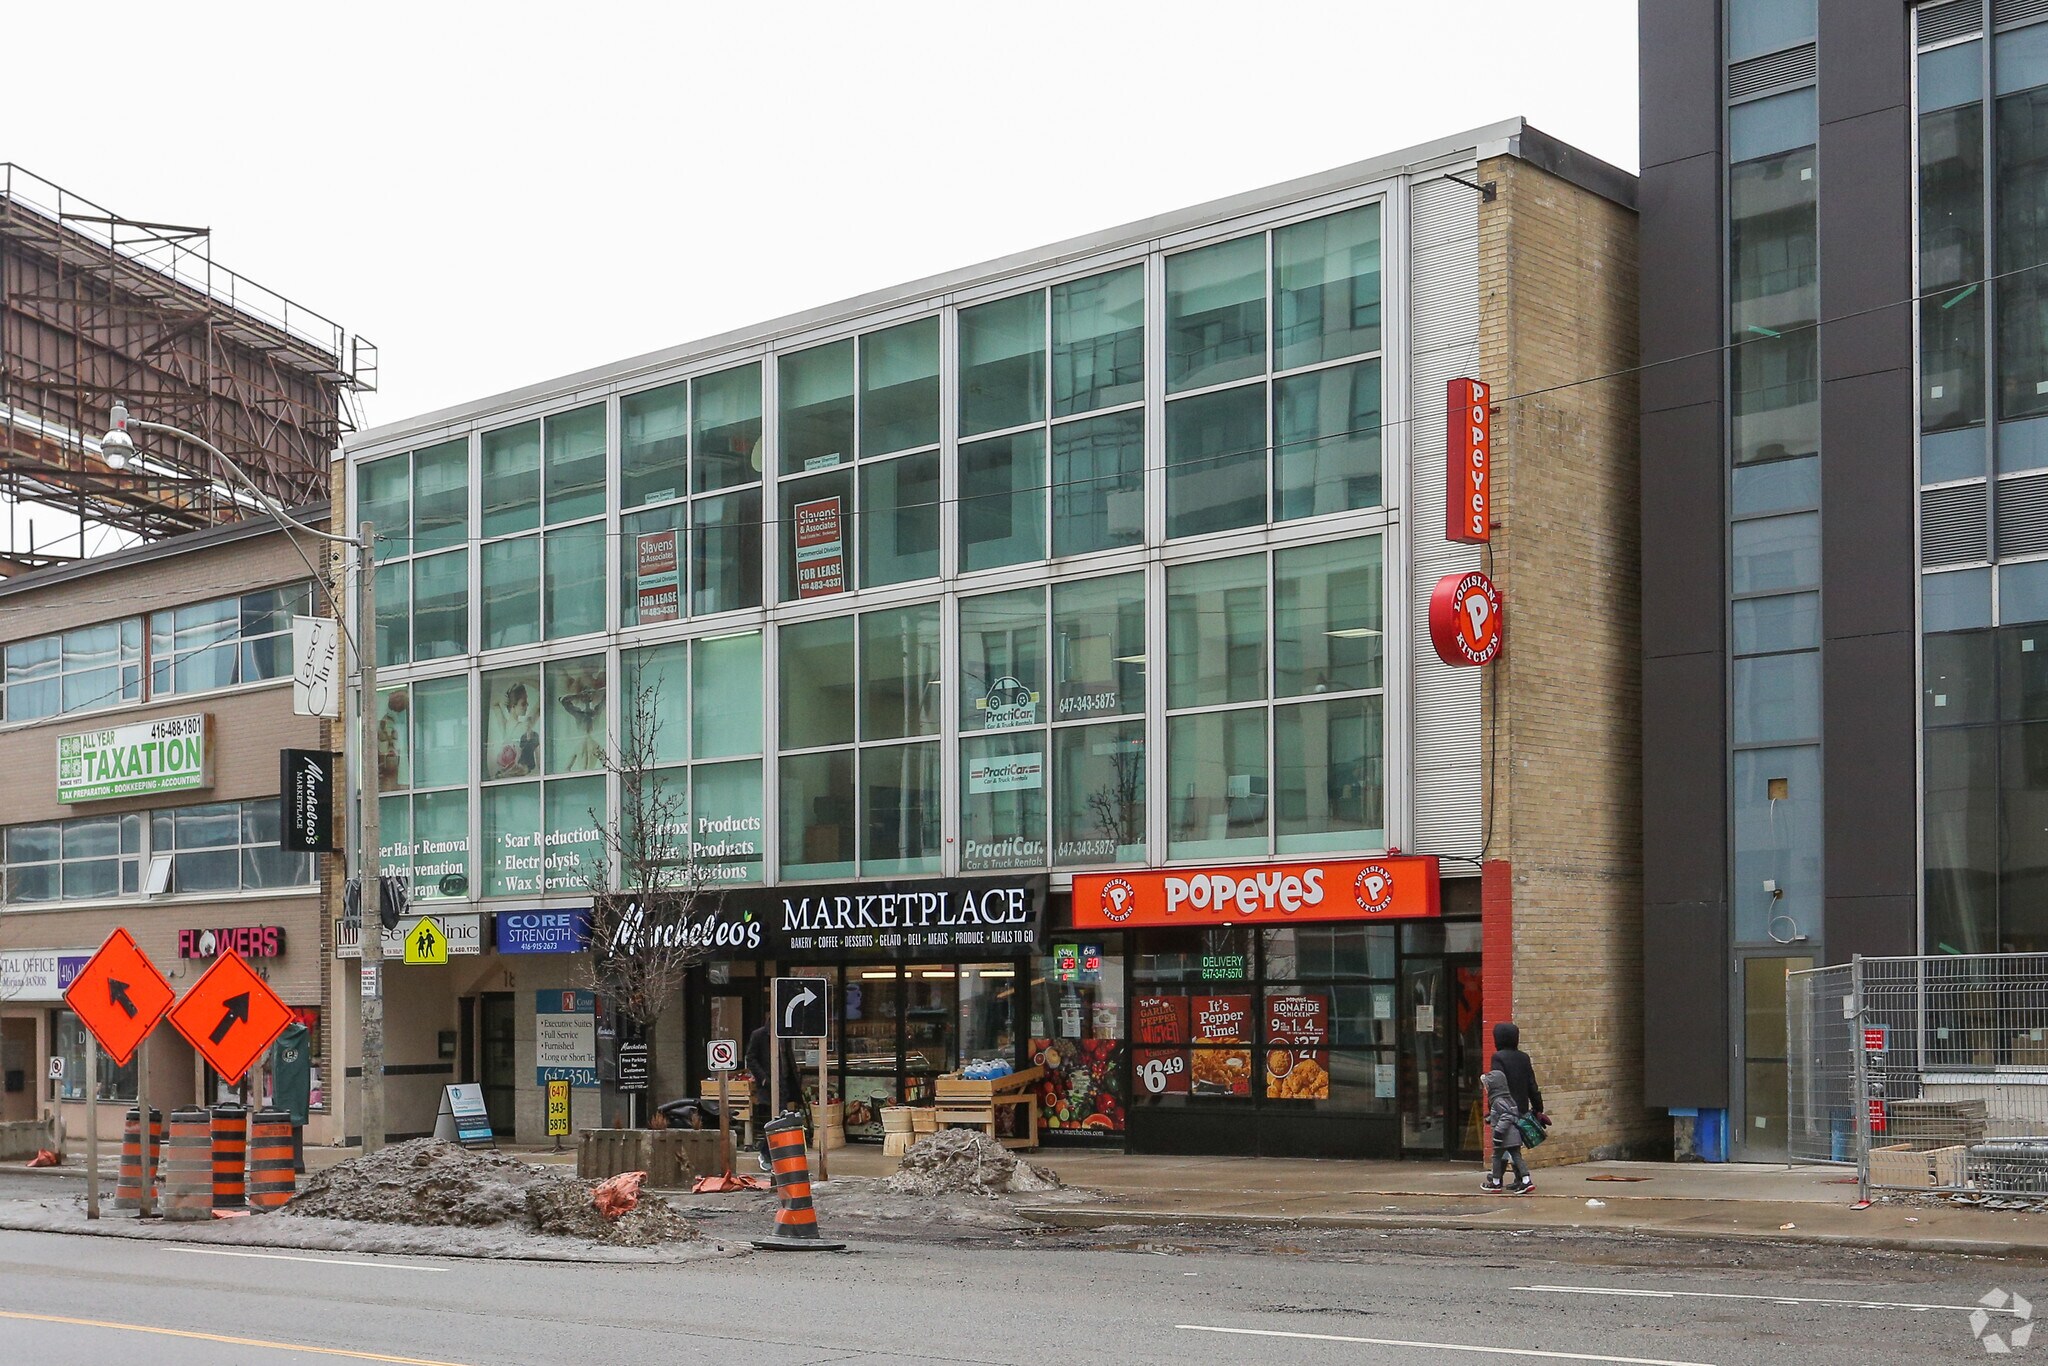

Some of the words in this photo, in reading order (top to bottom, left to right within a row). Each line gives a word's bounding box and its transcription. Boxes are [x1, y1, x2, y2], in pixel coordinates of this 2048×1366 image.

[800, 508, 836, 525] Slavens
[800, 525, 805, 534] &
[806, 520, 836, 533] Associates
[640, 539, 673, 555] Slavens
[797, 548, 823, 558] Commercial
[823, 545, 841, 556] Division
[646, 552, 674, 563] Associates
[800, 568, 816, 581] FOR
[817, 563, 840, 577] LEASE
[638, 577, 661, 587] Commercial
[662, 574, 677, 583] Division
[810, 577, 841, 591] 483-4337
[640, 594, 655, 608] FOR
[656, 591, 677, 605] LEASE
[1453, 575, 1498, 614] LOUISIANA
[649, 605, 677, 617] 483-4337
[1465, 594, 1488, 641] P
[294, 619, 322, 689] Laser
[1456, 632, 1499, 663] KITCHEN
[307, 633, 337, 717] Clinic
[1059, 692, 1115, 714] 647-343-5875
[985, 707, 1033, 723] PractiCar
[151, 717, 201, 739] 416-488-1801
[83, 734, 95, 750] ALL
[96, 730, 115, 748] YEAR
[83, 735, 201, 783] TAXATION
[983, 763, 1028, 778] PractiCar
[61, 791, 72, 799] TAX
[73, 786, 111, 799] PREPARATION
[114, 779, 157, 793] BOOKKEEPING
[161, 775, 200, 787] ACCOUNTING
[698, 815, 760, 834] Products
[505, 833, 530, 848] Scar
[534, 827, 600, 847] Reduction
[394, 842, 420, 857] Hair
[423, 836, 469, 854] Removal
[692, 840, 754, 858] Products
[964, 836, 1042, 859] PractiCar
[1058, 839, 1115, 857] 647-343-5875
[505, 851, 580, 872] Electrolysis
[966, 859, 980, 870] Car
[982, 859, 989, 869] &
[991, 858, 1012, 869] Truck
[1014, 855, 1043, 868] Rentals
[505, 875, 532, 891] Wax
[536, 873, 589, 890] Services
[1355, 865, 1392, 887] LOUISIANA
[1101, 878, 1134, 898] LOUISIANA
[1364, 875, 1384, 901] P
[1109, 887, 1127, 911] P
[1356, 895, 1392, 913] KITCHEN
[781, 888, 1028, 931] MARKETPLACE
[1103, 905, 1133, 922] KITCHEN
[507, 914, 570, 928] CORE
[178, 925, 279, 958] FLWERS
[508, 928, 571, 942] STRENGTH
[790, 936, 812, 949] BAKERY
[818, 935, 839, 949] COFFEE
[844, 934, 873, 948] DESSERTS
[879, 933, 901, 947] GELATO
[907, 933, 921, 946] DELI
[927, 932, 949, 945] MEATS
[955, 931, 984, 945] PRODUCE
[991, 930, 1013, 944] MEALS
[1014, 930, 1022, 943] TO
[1023, 929, 1034, 943] GO
[520, 942, 557, 950] 416-915-2673
[22, 957, 55, 973] OFFICE
[1062, 958, 1075, 970] 25
[1086, 957, 1100, 970] 20
[1202, 955, 1243, 968] DELIVERY
[1202, 968, 1243, 979] 647-347-5570
[1139, 999, 1149, 1008] Try
[1149, 998, 1160, 1006] Our
[1208, 999, 1230, 1013] It's
[1273, 1003, 1320, 1013] BONAFIDE
[1140, 1004, 1175, 1019] GARLIC
[1199, 1011, 1244, 1026] Pepper
[544, 1019, 573, 1028] Executive
[574, 1018, 593, 1028] Suites
[1141, 1013, 1177, 1028] PEPPER
[1271, 1018, 1280, 1032] 9
[1304, 1018, 1314, 1032] 4
[544, 1030, 556, 1039] Full
[556, 1030, 579, 1040] Service
[1202, 1022, 1240, 1039] Time!
[544, 1041, 575, 1051] Furnished
[544, 1052, 560, 1064] Long
[561, 1054, 568, 1062] or
[569, 1052, 586, 1063] Short
[549, 1084, 568, 1100] (647)
[550, 1102, 566, 1114] 343-
[550, 1118, 567, 1130] 5875
